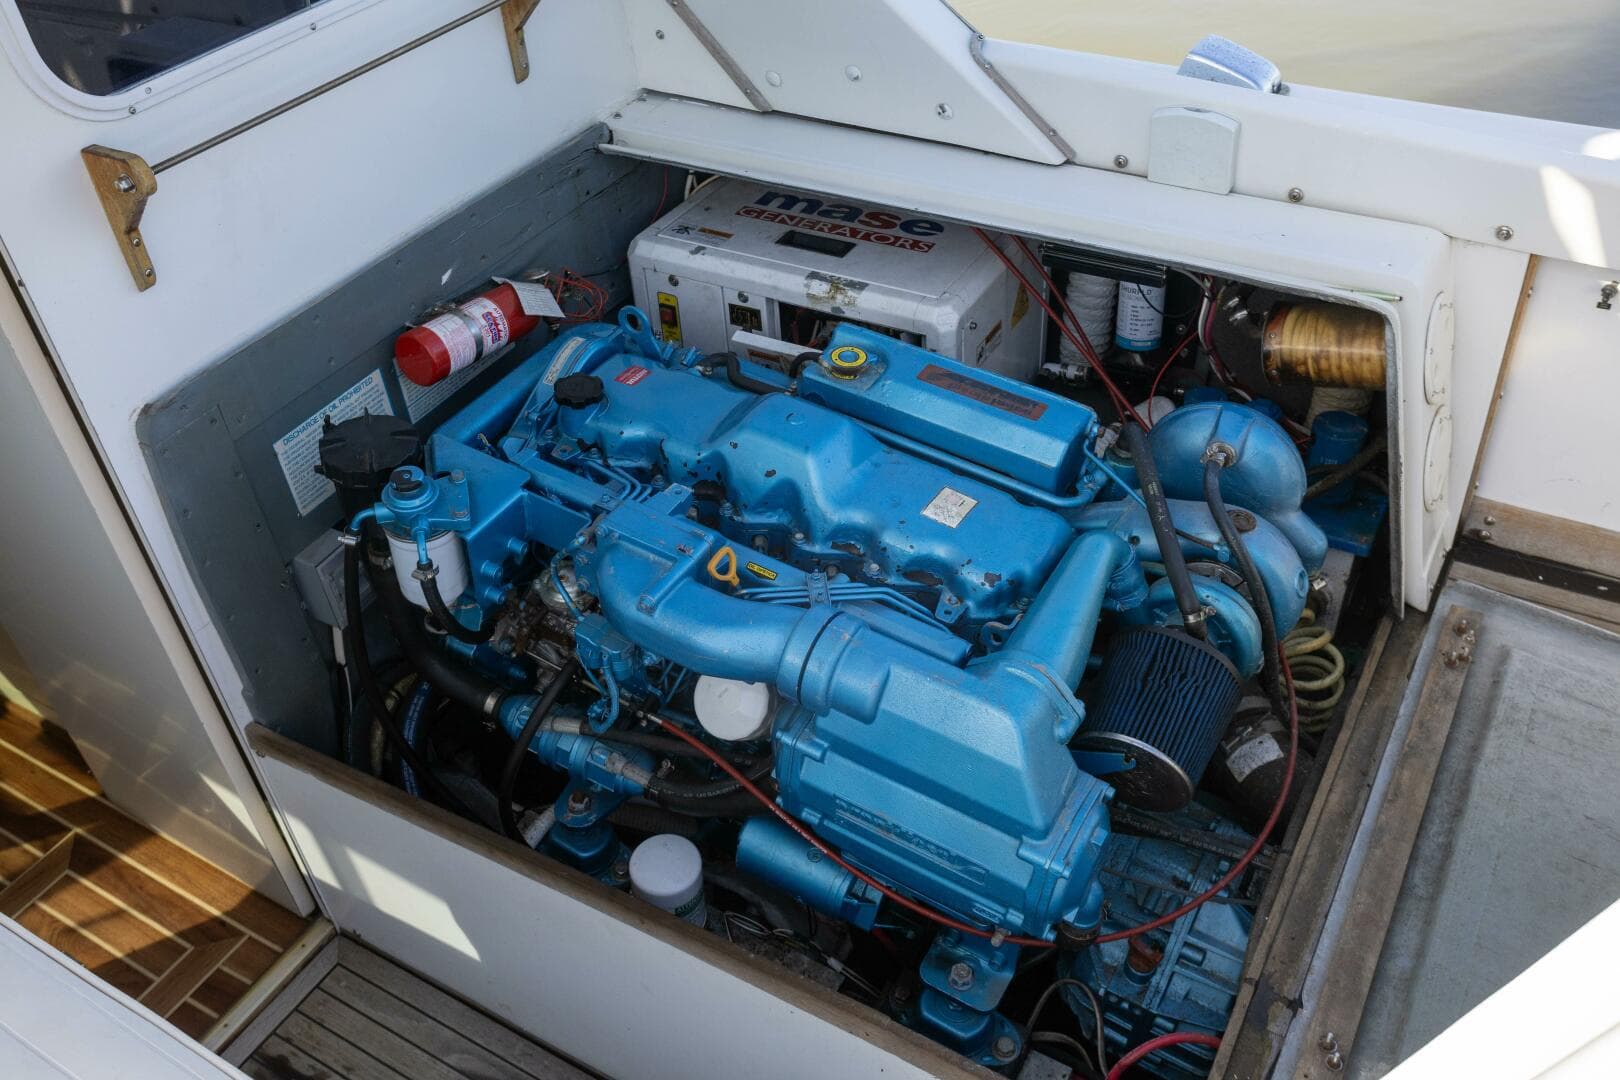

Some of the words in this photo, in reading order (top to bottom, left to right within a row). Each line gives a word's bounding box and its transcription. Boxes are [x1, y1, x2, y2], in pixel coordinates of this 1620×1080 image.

[739, 207, 935, 253] GENERATORS
[754, 191, 945, 236] mase
[282, 416, 320, 446] DISCHARGE
[329, 402, 338, 413] OIL
[338, 376, 373, 406] PROHIBITED
